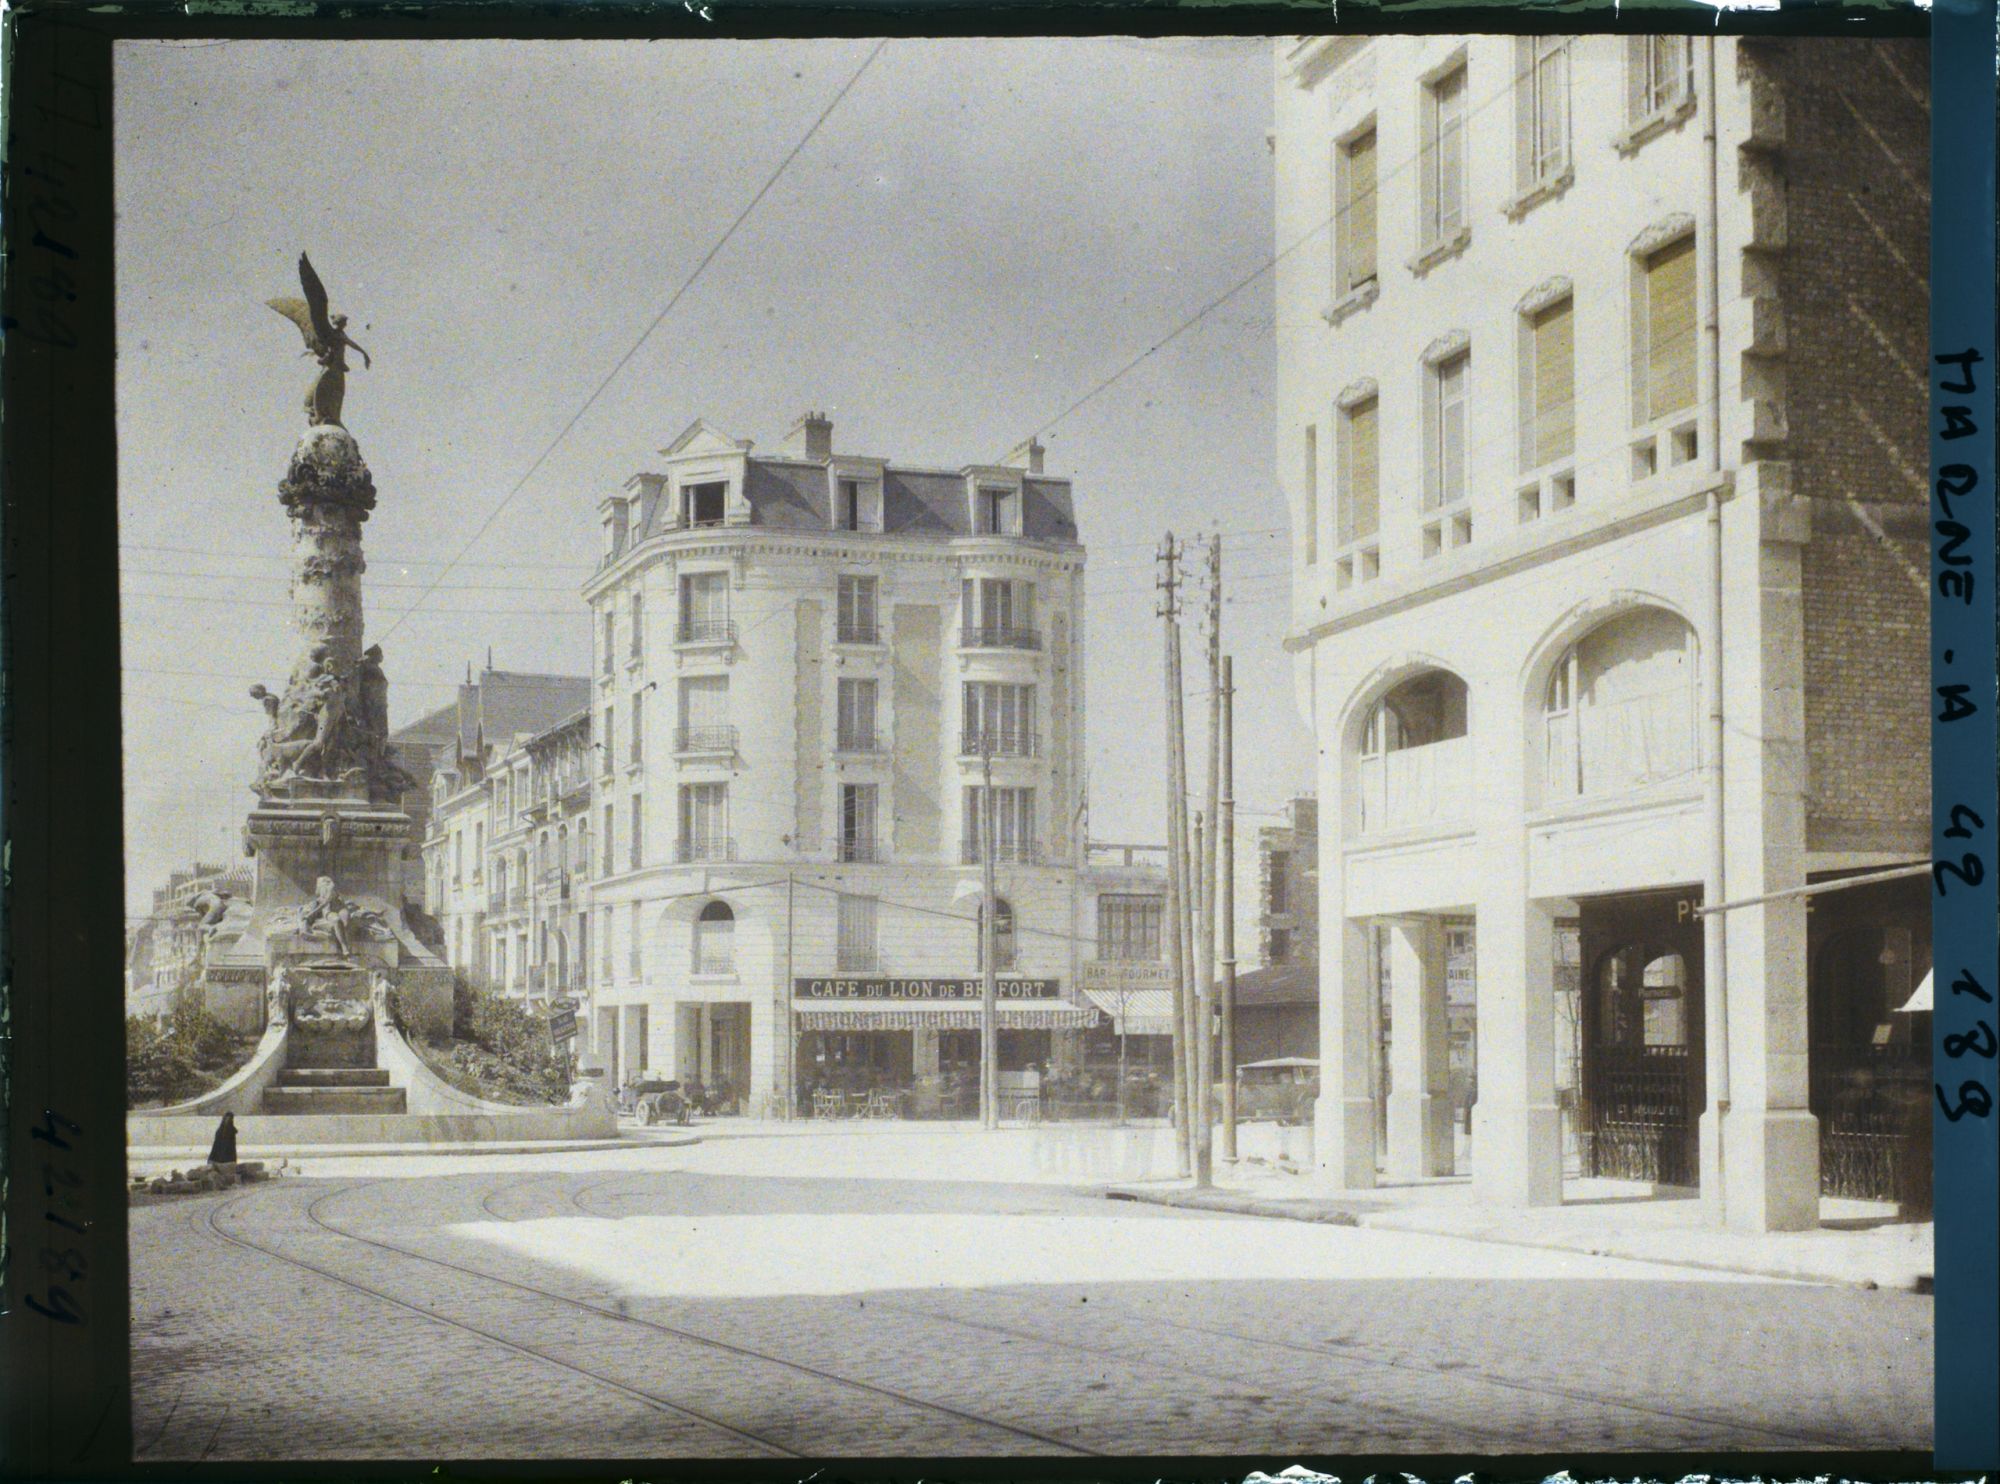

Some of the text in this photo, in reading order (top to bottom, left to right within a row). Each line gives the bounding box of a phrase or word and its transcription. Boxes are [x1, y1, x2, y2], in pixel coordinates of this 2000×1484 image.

[1936, 346, 1985, 606] MARNE
[1933, 803, 1985, 897] 42
[811, 981, 1045, 997] CAFE DU LION DE BEFORT
[1935, 968, 1997, 1123] 189
